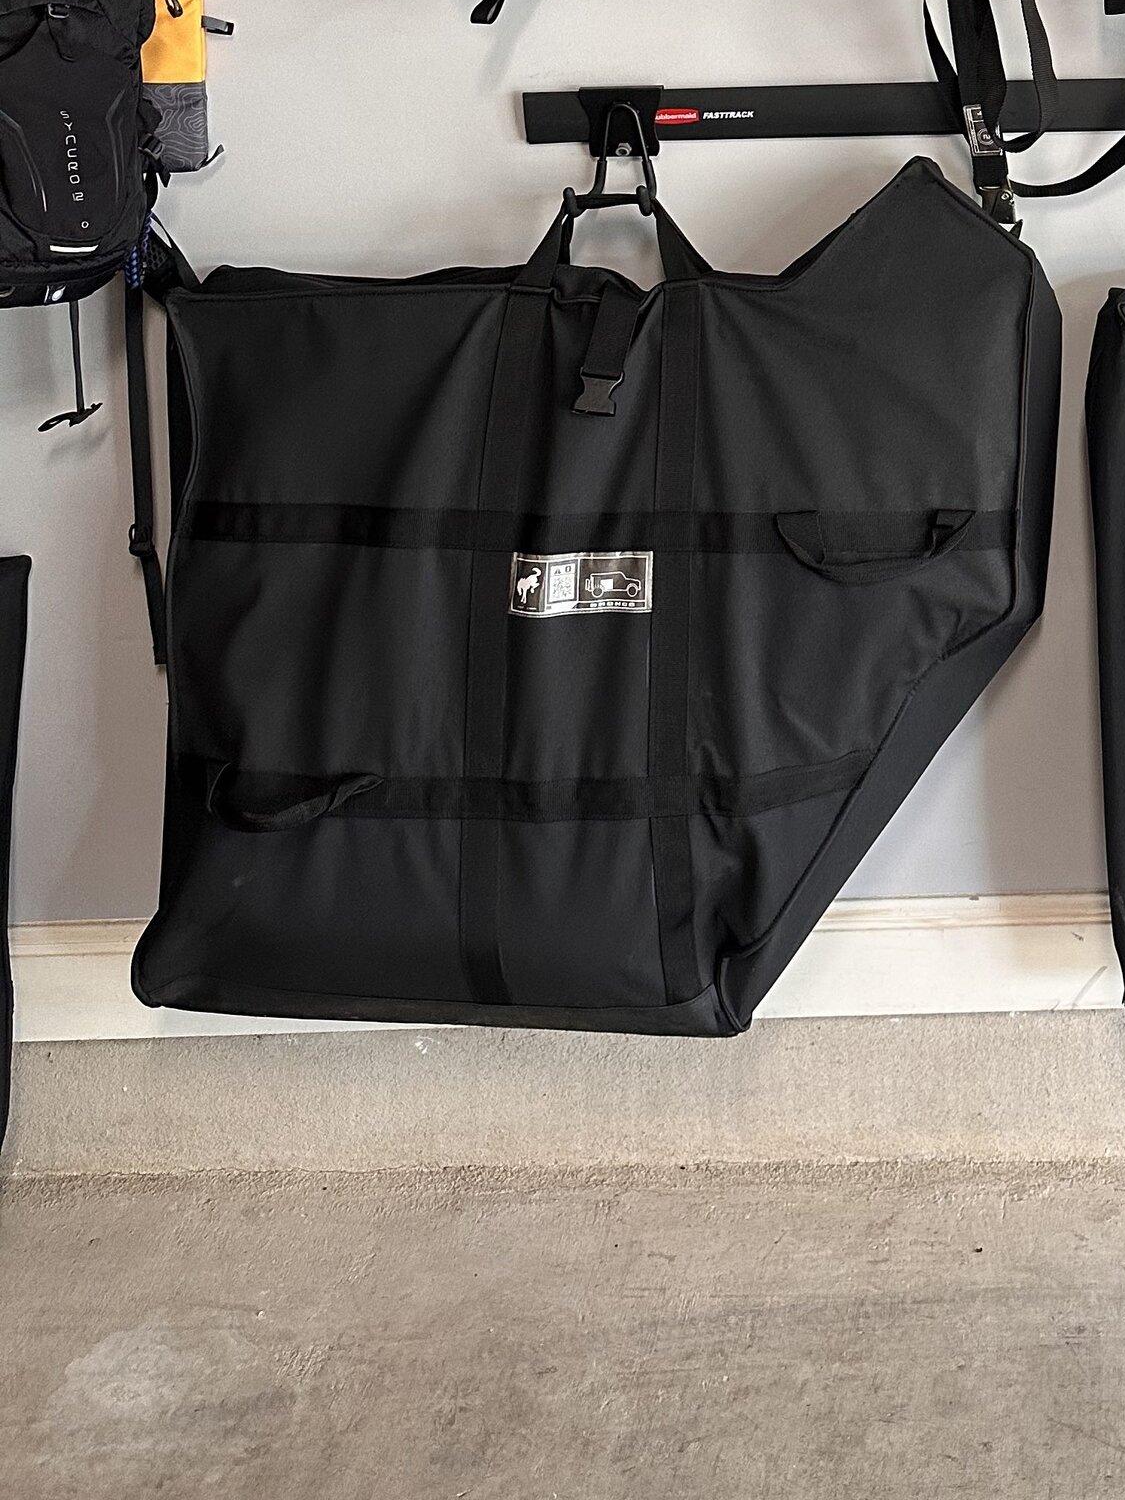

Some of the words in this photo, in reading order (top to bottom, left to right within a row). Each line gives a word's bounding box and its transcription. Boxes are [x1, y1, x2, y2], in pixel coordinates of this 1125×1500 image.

[655, 112, 697, 120] ubbermaid
[702, 111, 754, 119] FASTTRACK
[72, 192, 84, 201] 12
